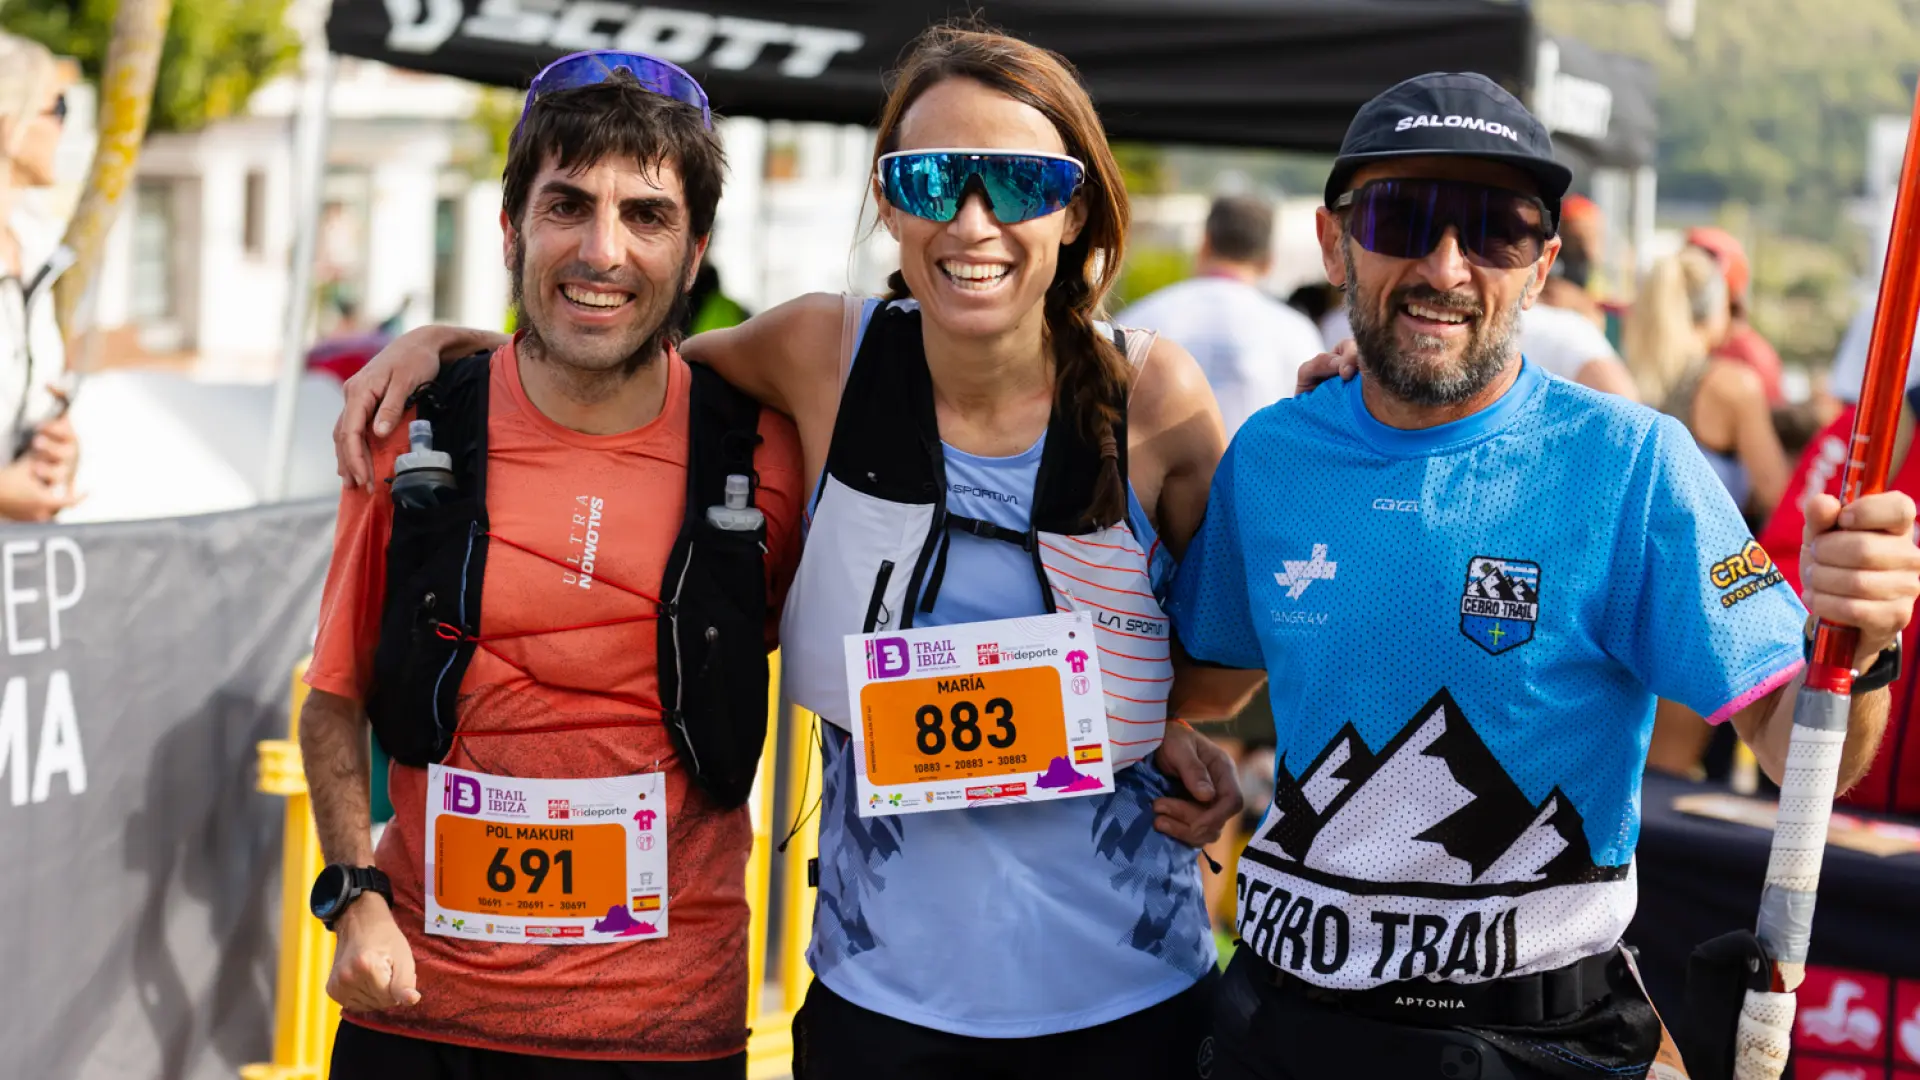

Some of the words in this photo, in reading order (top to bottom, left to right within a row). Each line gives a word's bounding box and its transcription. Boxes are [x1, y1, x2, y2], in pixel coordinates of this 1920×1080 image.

[463, 0, 865, 78] SCOTT
[1395, 115, 1518, 141] SALOMON
[953, 484, 1018, 505] SPORTIVA
[579, 496, 604, 590] SALOMON
[1721, 580, 1758, 608] SPORT
[1756, 570, 1784, 590] NUT
[1503, 602, 1533, 618] TRAIL
[1098, 612, 1120, 628] LA
[914, 639, 956, 654] TRAIL
[1000, 647, 1058, 660] Trideporte
[917, 652, 957, 667] IBIZA
[937, 674, 985, 694] MARÍA
[915, 697, 1018, 755] 883
[914, 762, 940, 773] 10883
[955, 758, 983, 770] 20883
[997, 754, 1027, 766] 30883
[486, 788, 527, 802] TRAIL
[488, 800, 527, 813] IBIZA
[571, 806, 627, 818] Trideporte
[486, 824, 512, 839] POL
[516, 827, 574, 841] MAKURI
[486, 847, 573, 895] 691
[478, 897, 502, 908] 10691
[517, 900, 544, 909] 20691
[560, 901, 586, 910] 30691
[1395, 997, 1466, 1009] APTONIA
